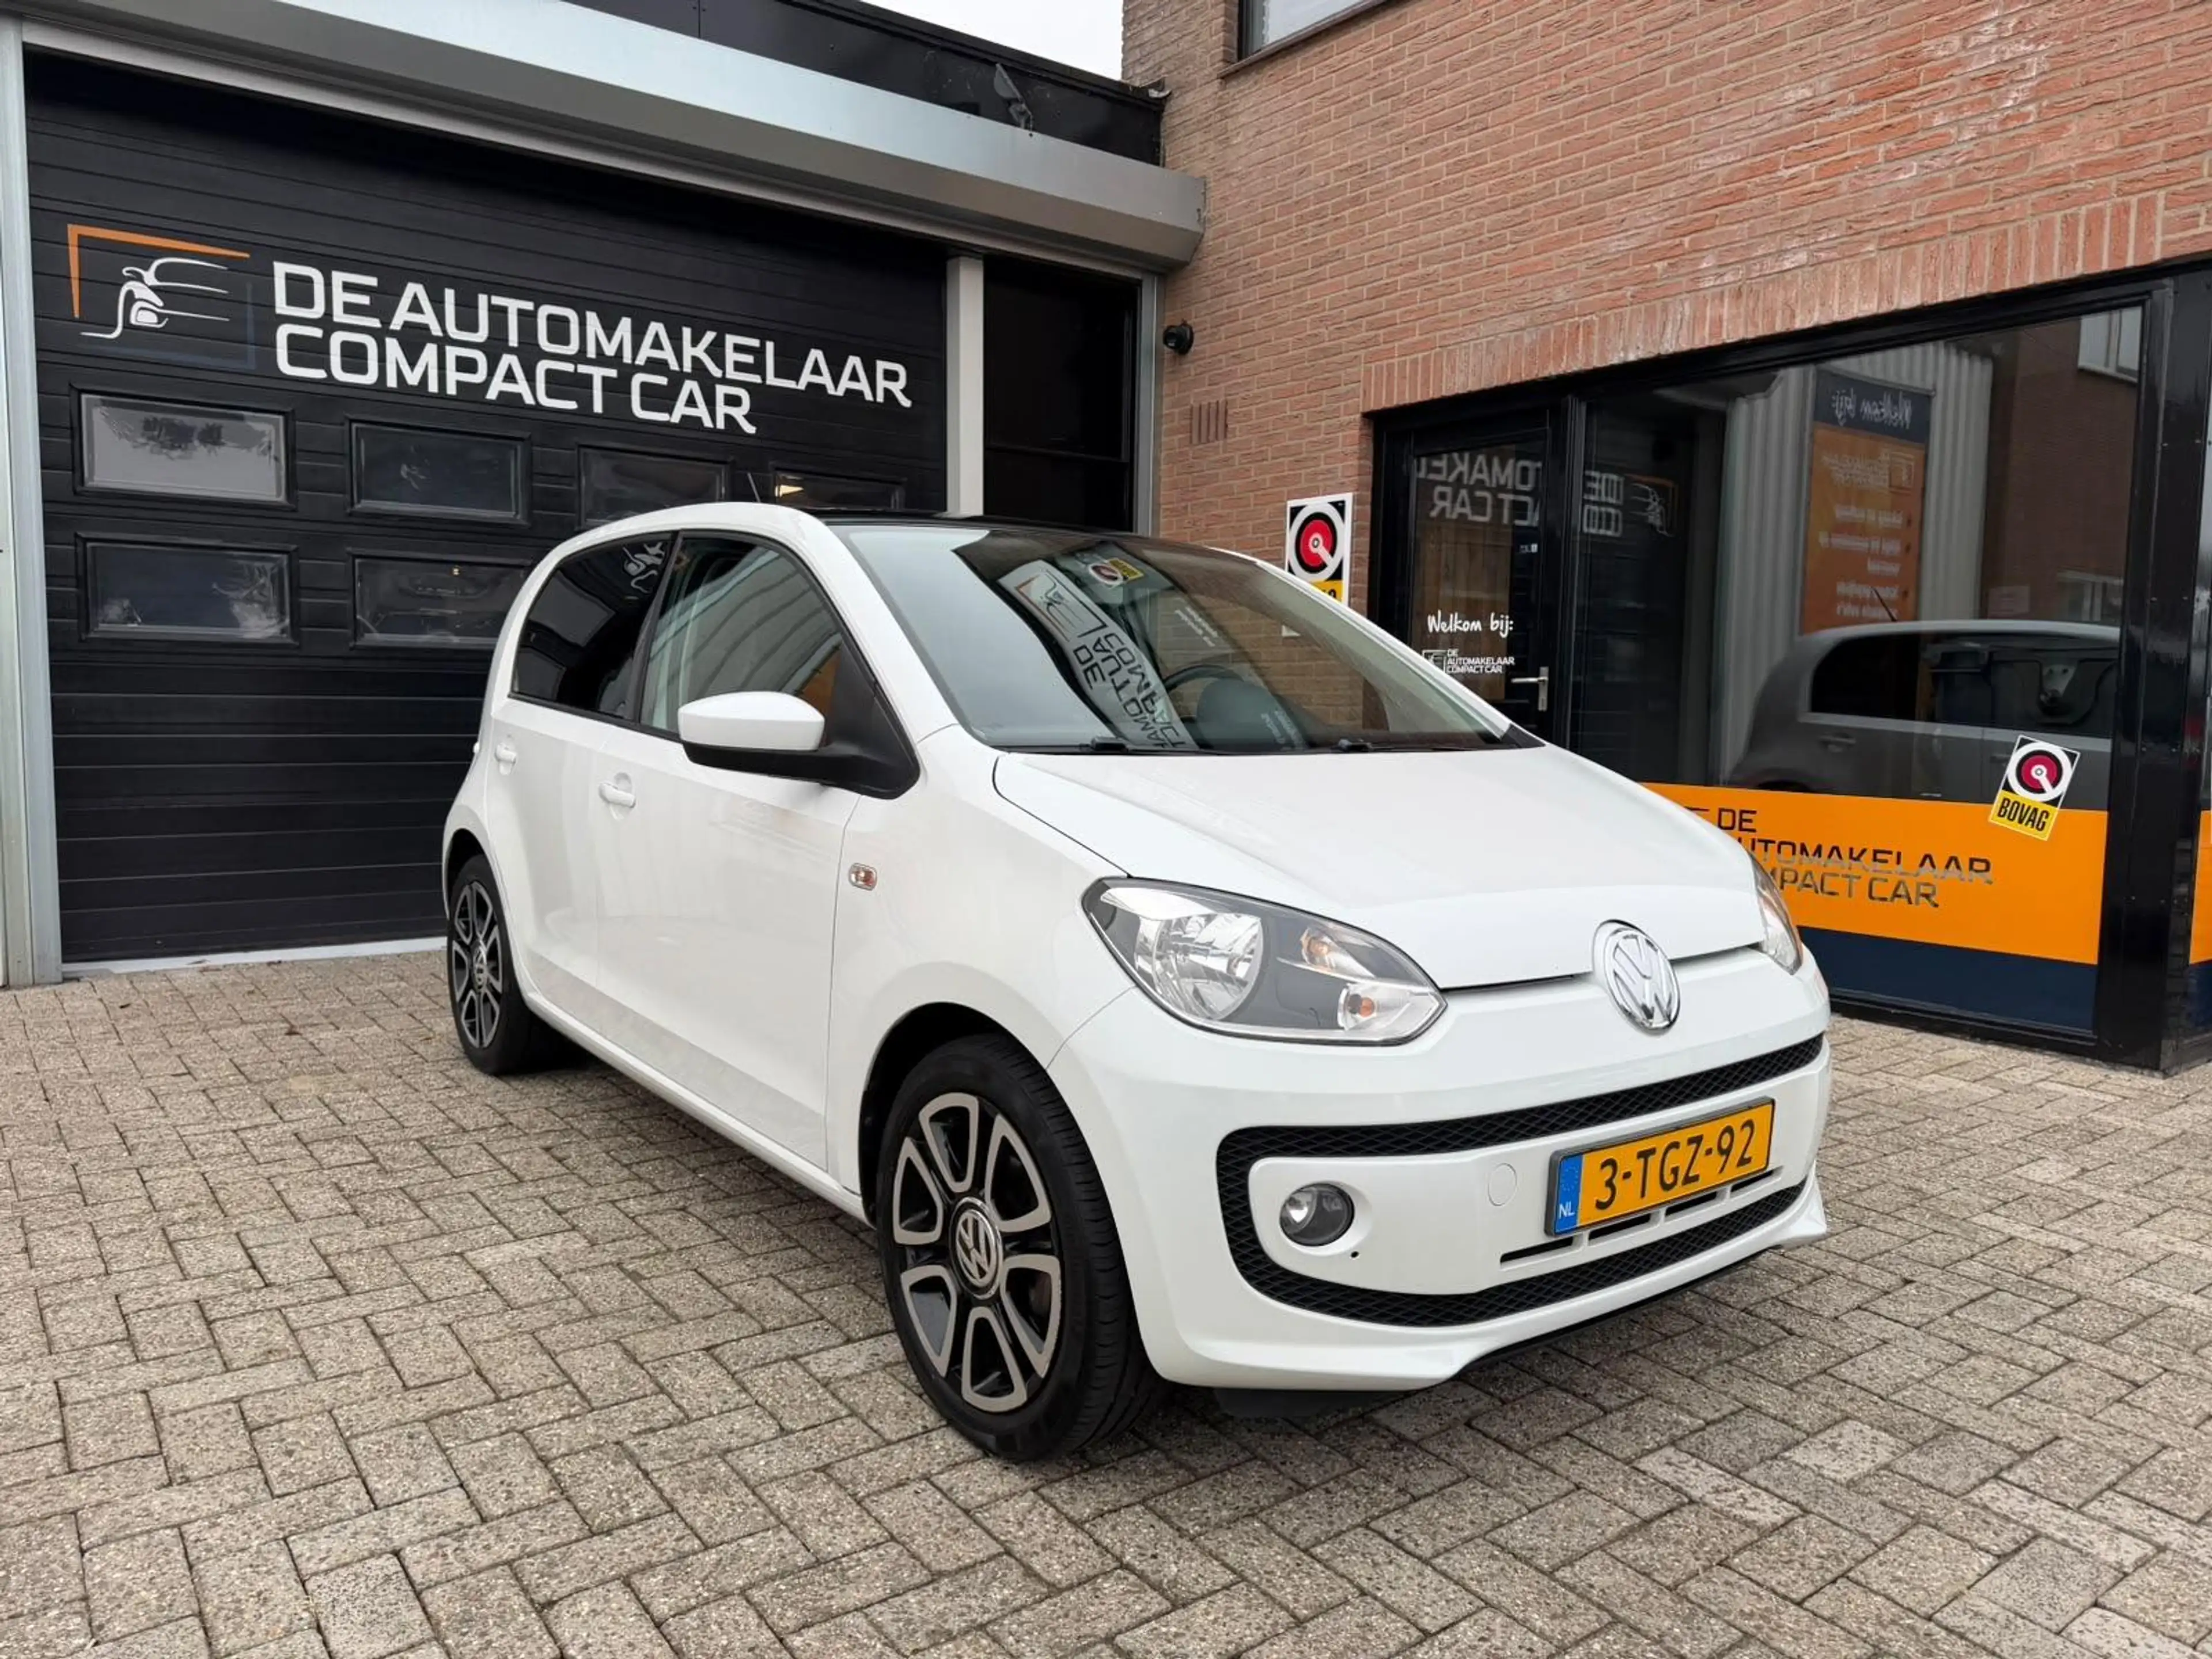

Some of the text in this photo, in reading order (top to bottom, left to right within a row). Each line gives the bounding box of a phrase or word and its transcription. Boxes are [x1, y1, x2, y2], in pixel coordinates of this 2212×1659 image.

[273, 261, 912, 408] DE AUTOMAKELAAR
[276, 323, 757, 434] COMPACT CAR
[1427, 609, 1514, 638] Welkom bij:
[1717, 808, 1758, 833] DE
[1997, 797, 2051, 832] BOVAG
[1868, 878, 1940, 908] CAR
[1594, 1118, 1755, 1211] 3-TGZ-92
[1559, 1201, 1575, 1219] NL
